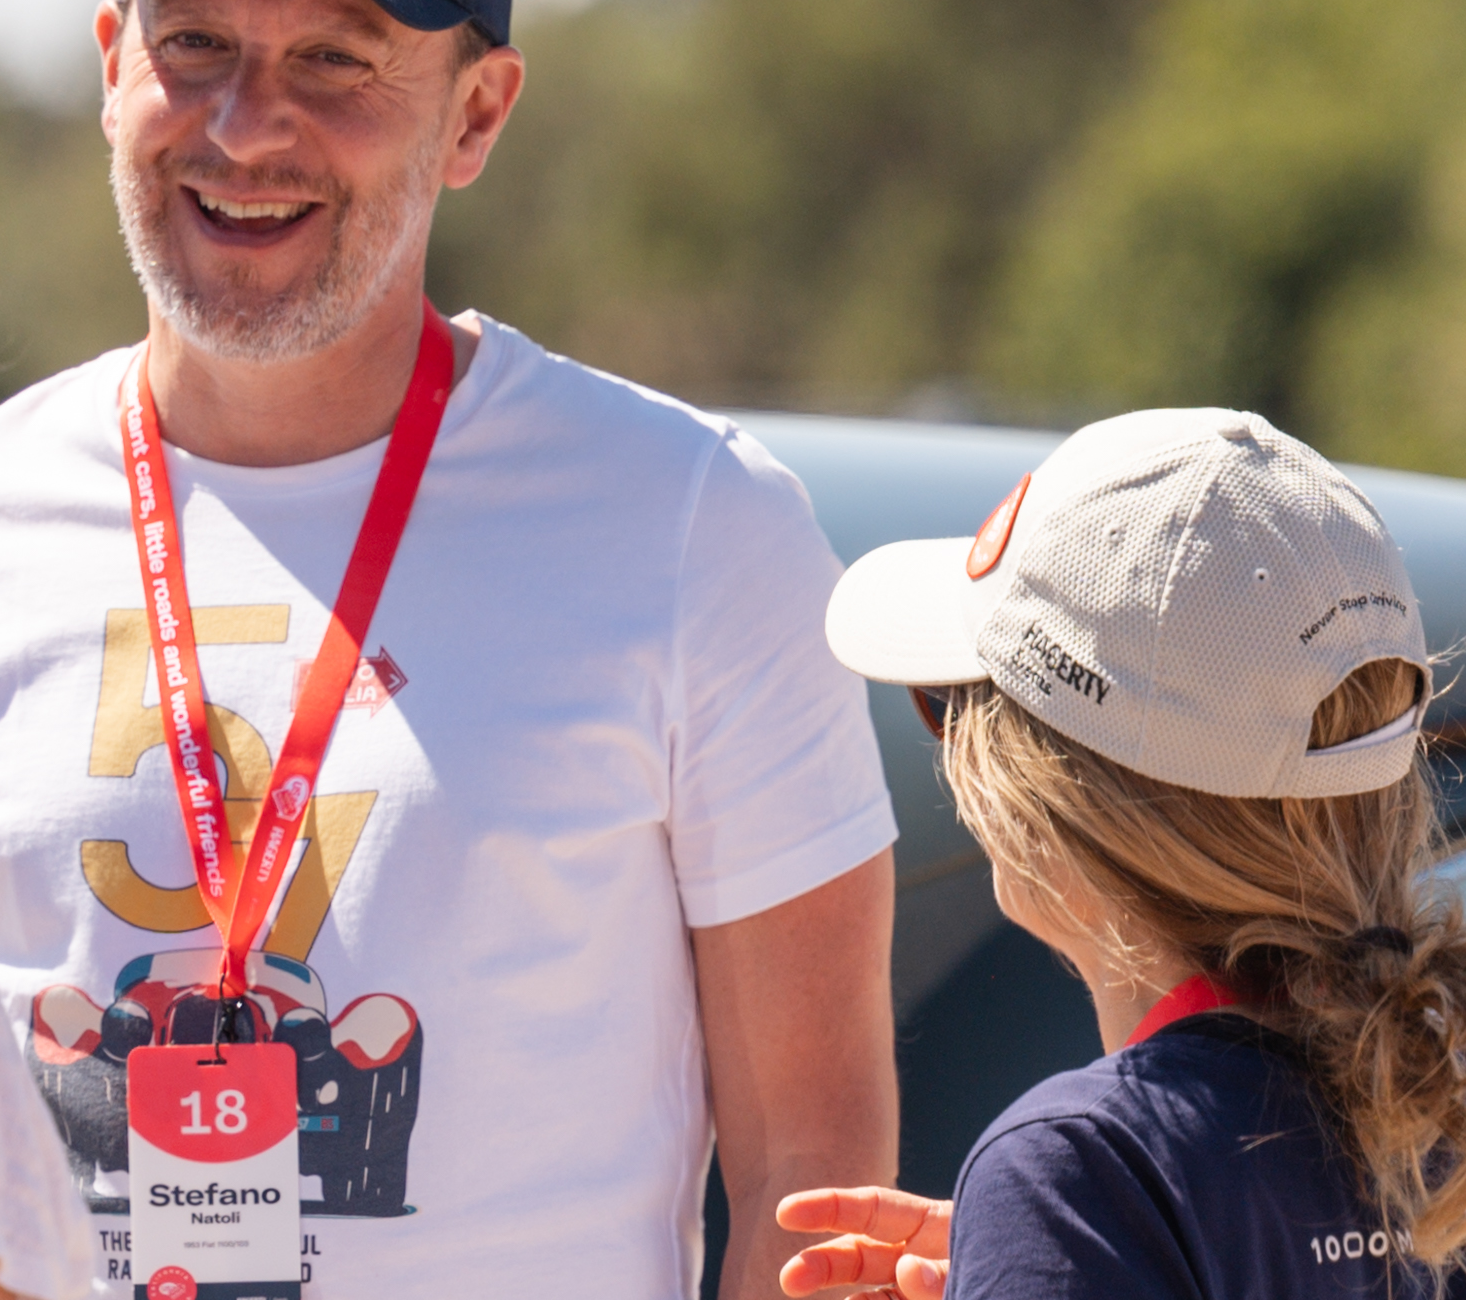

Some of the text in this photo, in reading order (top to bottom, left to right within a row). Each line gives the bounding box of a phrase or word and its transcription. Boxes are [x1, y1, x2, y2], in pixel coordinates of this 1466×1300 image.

[135, 460, 157, 520] cars,
[143, 520, 169, 575] little
[152, 578, 180, 640] roads
[1299, 606, 1337, 645] Never
[1339, 596, 1368, 611] Stop
[163, 644, 189, 688] and
[1023, 620, 1111, 705] HAGERTY
[170, 688, 212, 809] wonderful
[195, 811, 223, 898] friends
[179, 1089, 249, 1135] 18
[149, 1183, 281, 1207] Stefano
[191, 1211, 241, 1224] Natoli
[1310, 1230, 1390, 1264] 1000
